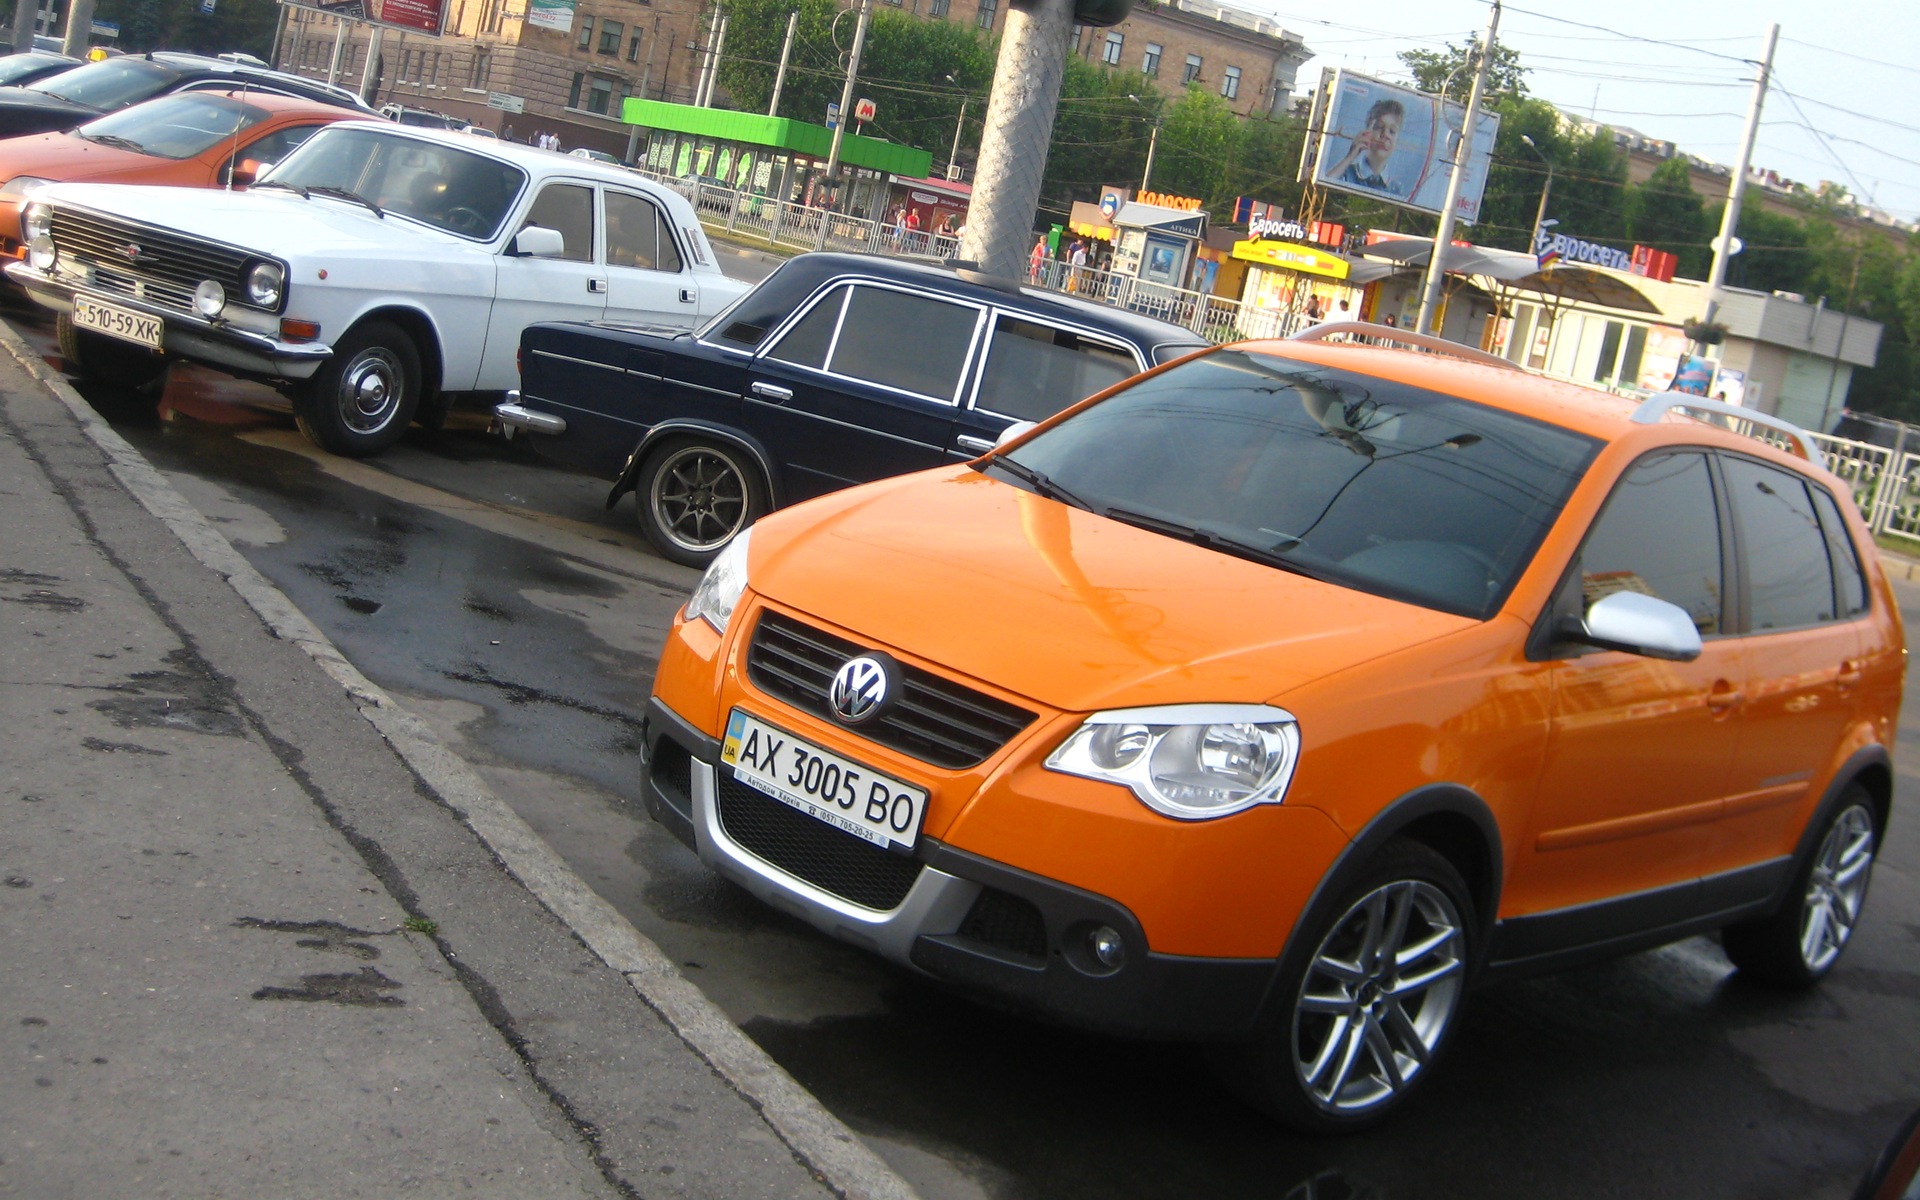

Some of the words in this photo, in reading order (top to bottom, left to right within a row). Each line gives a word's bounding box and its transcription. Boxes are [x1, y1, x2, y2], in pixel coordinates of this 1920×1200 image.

[1136, 190, 1202, 213] КОЛОСОК
[1249, 212, 1304, 239] Евросеть
[1534, 219, 1631, 272] Евросеть
[88, 304, 133, 334] 510-59
[724, 744, 735, 759] UA
[788, 747, 860, 810] 3005
[746, 776, 776, 796] Автодом
[819, 810, 837, 825] (057)
[840, 820, 874, 841] 705-20-25
